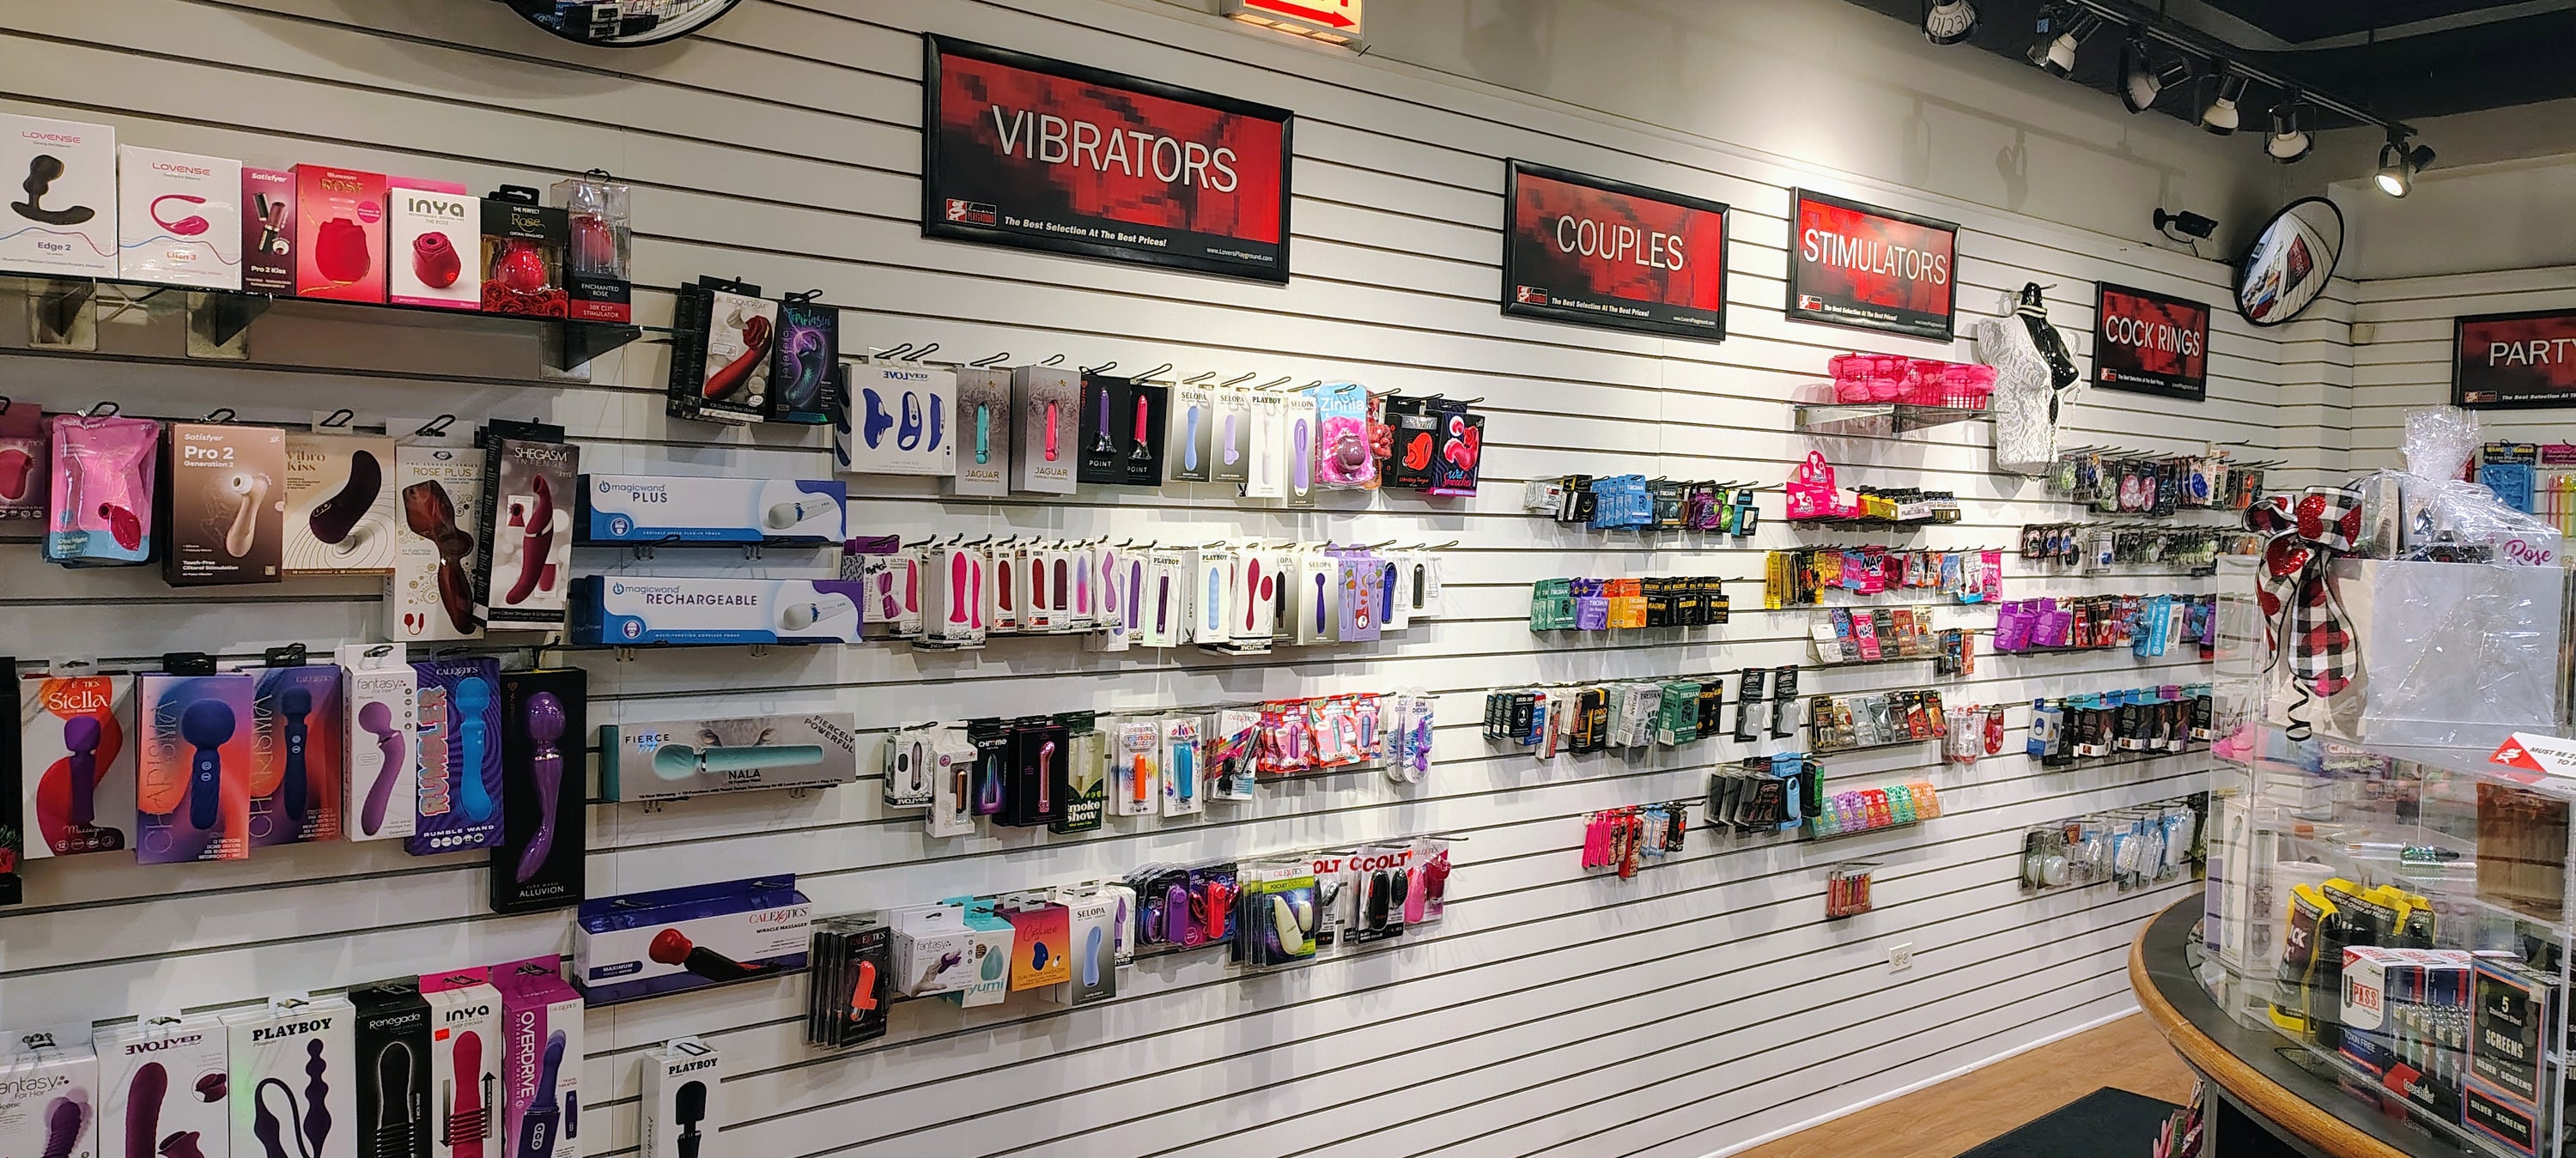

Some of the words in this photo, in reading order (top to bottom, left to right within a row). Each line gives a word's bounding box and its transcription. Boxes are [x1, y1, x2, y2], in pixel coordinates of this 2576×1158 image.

[21, 130, 82, 144] LOVENSE
[992, 104, 1237, 193] VIBRATORS
[152, 161, 211, 176] LOVENSE
[251, 173, 288, 183] Satisfyer
[511, 213, 546, 233] Rose
[1005, 216, 1020, 227] The
[1023, 219, 1044, 230] Best
[1046, 221, 1086, 236] Selection
[1088, 228, 1099, 238] At
[1101, 230, 1115, 240] The
[1117, 233, 1137, 244] Best
[1139, 235, 1167, 247] Prices!
[38, 241, 64, 252] Edge
[1557, 215, 1684, 271] COUPLES
[1206, 247, 1273, 262] www.LoversPlayground.com
[1803, 228, 1947, 285] STIMULATORS
[581, 282, 620, 293] ENCHANTED
[1552, 297, 1561, 306] The
[1563, 299, 1575, 307] Best
[1576, 300, 1601, 311] Selection
[1609, 305, 1618, 313] The
[1619, 306, 1631, 315] Best
[2105, 314, 2154, 349] COCK
[2158, 324, 2201, 357] RINGS
[1181, 391, 1207, 401] SELOPA
[1252, 396, 1281, 404] PLAYBOY
[184, 433, 224, 442] Satisfyer
[184, 446, 219, 460] Pro
[222, 446, 234, 460] 2
[287, 451, 326, 464] Vibro
[513, 447, 568, 462] SHEGASM
[286, 461, 317, 472] Kiss
[516, 459, 564, 469] INTENSE
[1089, 459, 1113, 468] POINT
[413, 468, 441, 476] ROSE
[445, 468, 472, 477] PLUS
[964, 470, 1000, 479] JAGUAR
[1034, 466, 1069, 476] JAGUAR
[611, 483, 665, 494] magicwand
[632, 492, 668, 503] PLUS
[2503, 539, 2555, 567] Rose
[1153, 557, 1180, 566] PLAYBOY
[625, 584, 680, 595] magicwand
[646, 593, 757, 606] RECHARGEABLE
[357, 678, 400, 691] fantasy
[48, 690, 109, 711] Stella
[804, 718, 854, 754] POWERFUL
[812, 714, 855, 744] FIERCELY
[625, 733, 671, 743] FIERCE
[2529, 747, 2555, 755] MUST
[728, 769, 762, 779] NALA
[423, 828, 463, 838] RUMBLE
[465, 824, 495, 833] WAND
[1363, 852, 1409, 872] COLT
[519, 885, 564, 898] ALLUVION
[749, 907, 808, 924] CALEXOTICS
[1077, 906, 1106, 918] SELOPA
[756, 925, 779, 934] MIRACLE
[780, 923, 808, 932] MASSAGER
[916, 940, 945, 951] fantasy
[602, 962, 634, 973] MAXIMUM
[969, 979, 1005, 996] yumi
[2354, 984, 2377, 1006] PASS
[2501, 996, 2509, 1013] 5
[369, 1012, 421, 1030] Renegade
[252, 1017, 332, 1041] PLAYBOY
[2360, 1038, 2376, 1052] FREE
[2485, 1028, 2524, 1059] SCREENS
[520, 1011, 535, 1098] OVERDRIVE
[669, 1058, 718, 1076] PLAYBOY
[2476, 1058, 2497, 1076] SILVER
[2500, 1070, 2533, 1093] SCREENS
[0, 1076, 58, 1094] antasy
[2470, 1099, 2493, 1117] SILVER
[2495, 1112, 2527, 1134] SCREENS
